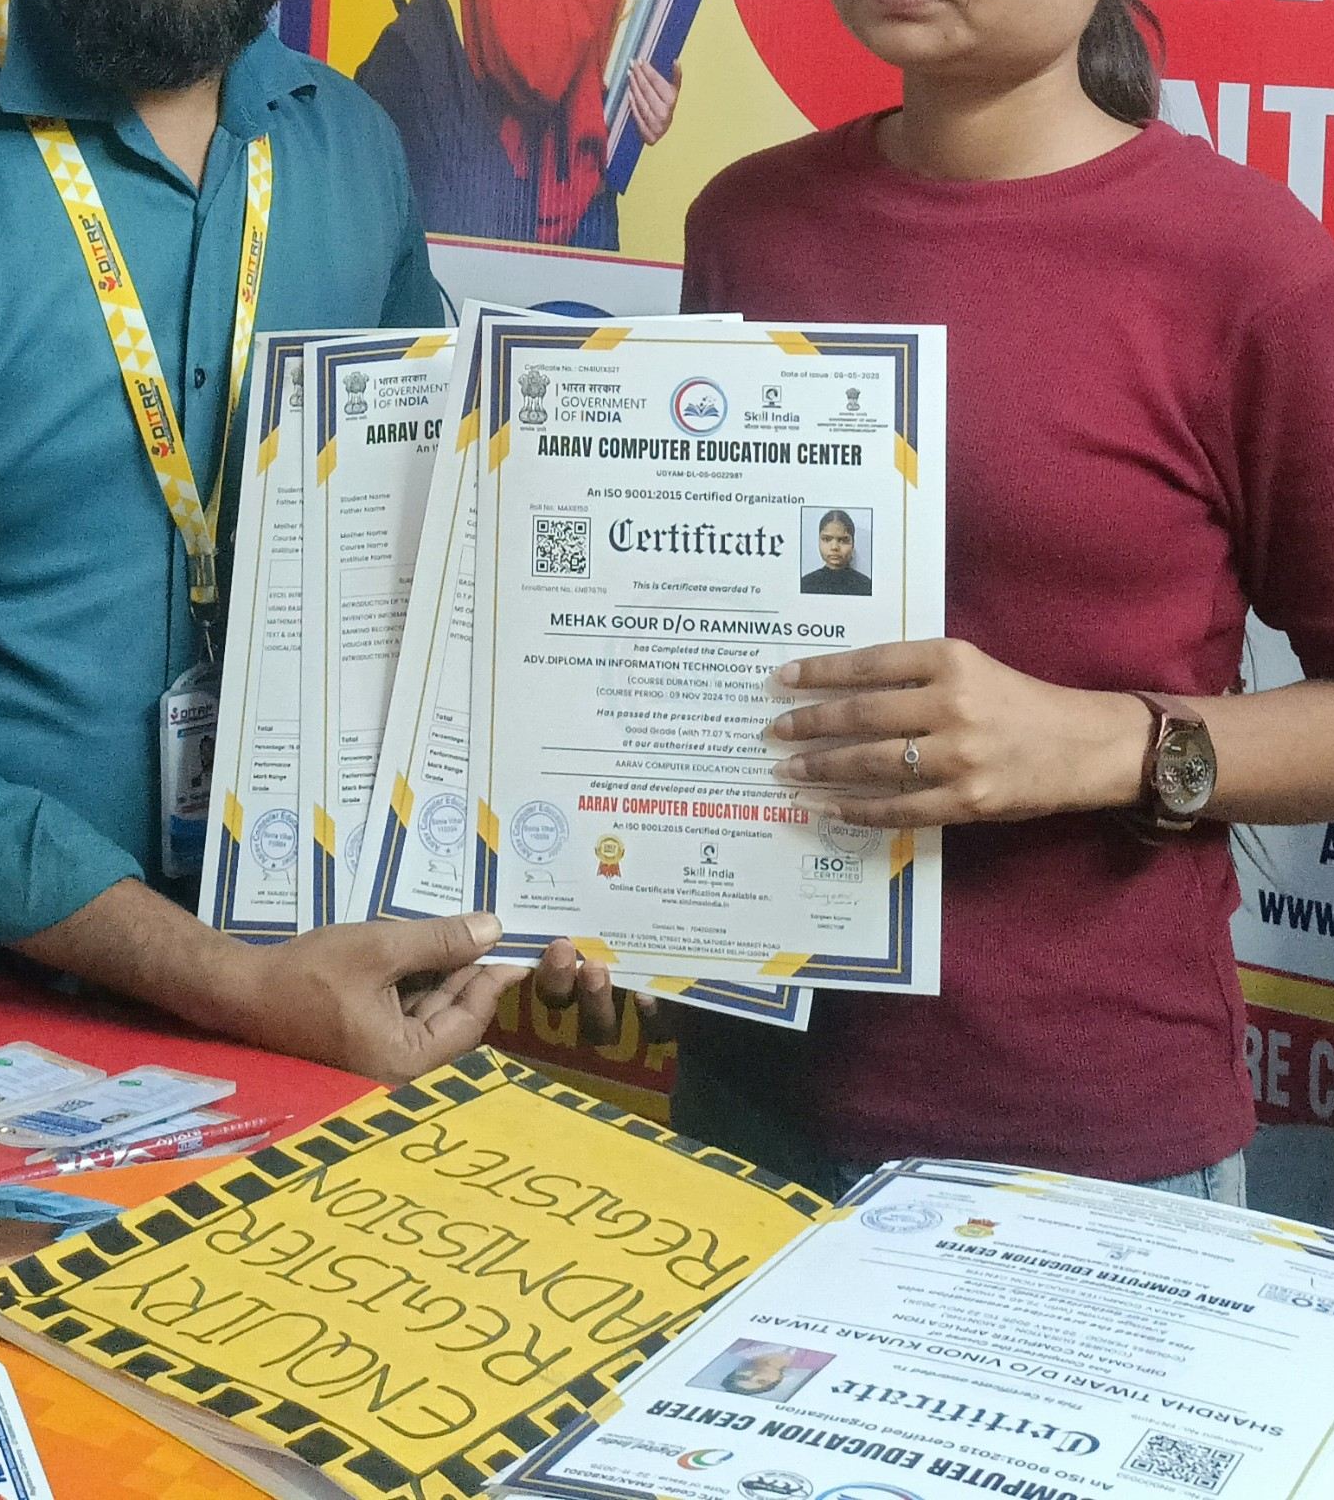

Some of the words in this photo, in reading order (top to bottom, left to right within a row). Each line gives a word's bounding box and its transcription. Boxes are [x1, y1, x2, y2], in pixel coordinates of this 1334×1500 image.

[378, 383, 449, 397] GOVERNMENT
[562, 383, 586, 394] भारत
[589, 383, 621, 394] सरकार
[379, 398, 392, 408] OF
[395, 396, 429, 407] INDIA
[561, 396, 646, 409] GOVERNMENT
[561, 411, 577, 422] OF
[581, 411, 622, 423] INDIA
[744, 412, 768, 422] Skill
[771, 412, 800, 422] India
[366, 420, 418, 445] AARAV
[537, 434, 593, 459] AARAV
[598, 436, 691, 461] COMPUTER
[696, 439, 791, 465] EDUCATION
[796, 442, 863, 467] CENTER
[587, 488, 601, 498] An
[604, 488, 622, 498] ISO
[625, 489, 682, 500] 9001:2015
[685, 491, 732, 503] Certified
[735, 493, 805, 504] Organization
[608, 518, 785, 558] Certificate
[550, 613, 607, 628] MEHAK
[611, 615, 658, 631] GOUR
[663, 615, 695, 633] D/O
[700, 620, 792, 636] RAMNIWAS
[797, 623, 845, 638] GOUR
[523, 654, 593, 666] ADV.DIPLOMA
[596, 658, 606, 666] IN
[608, 659, 680, 670] INFORMATION
[682, 662, 754, 674] TECHNOLOGY
[578, 795, 618, 814] AARAV
[622, 797, 689, 817] COMPUTER
[693, 801, 759, 821] EDUCATION
[763, 804, 809, 824] CENTER
[814, 857, 844, 872] ISO
[398, 1119, 751, 1292] REGISTER
[301, 1164, 673, 1354] ADMISSION
[935, 1239, 997, 1258] CENTER
[1000, 1250, 1093, 1277] EDUCATION
[203, 1197, 573, 1389] REGISTER
[1097, 1270, 1190, 1299] COMPUTER
[1195, 1293, 1255, 1313] AARAV
[749, 1314, 829, 1334] TIWARI
[90, 1260, 480, 1441] ENQUIRY
[836, 1328, 922, 1351] KUMAR
[926, 1345, 1002, 1368] VINOD
[1009, 1362, 1059, 1380] D/O
[1065, 1374, 1150, 1403] TIWARI
[645, 1399, 756, 1431] CENTER
[774, 1403, 878, 1432] Organization
[830, 1380, 1101, 1456] Certificate
[1160, 1397, 1284, 1436] SHARDHA
[757, 1419, 924, 1469] EDUCATION
[880, 1426, 955, 1449] Certified
[1054, 1470, 1085, 1484] ISO
[1090, 1480, 1113, 1491] An
